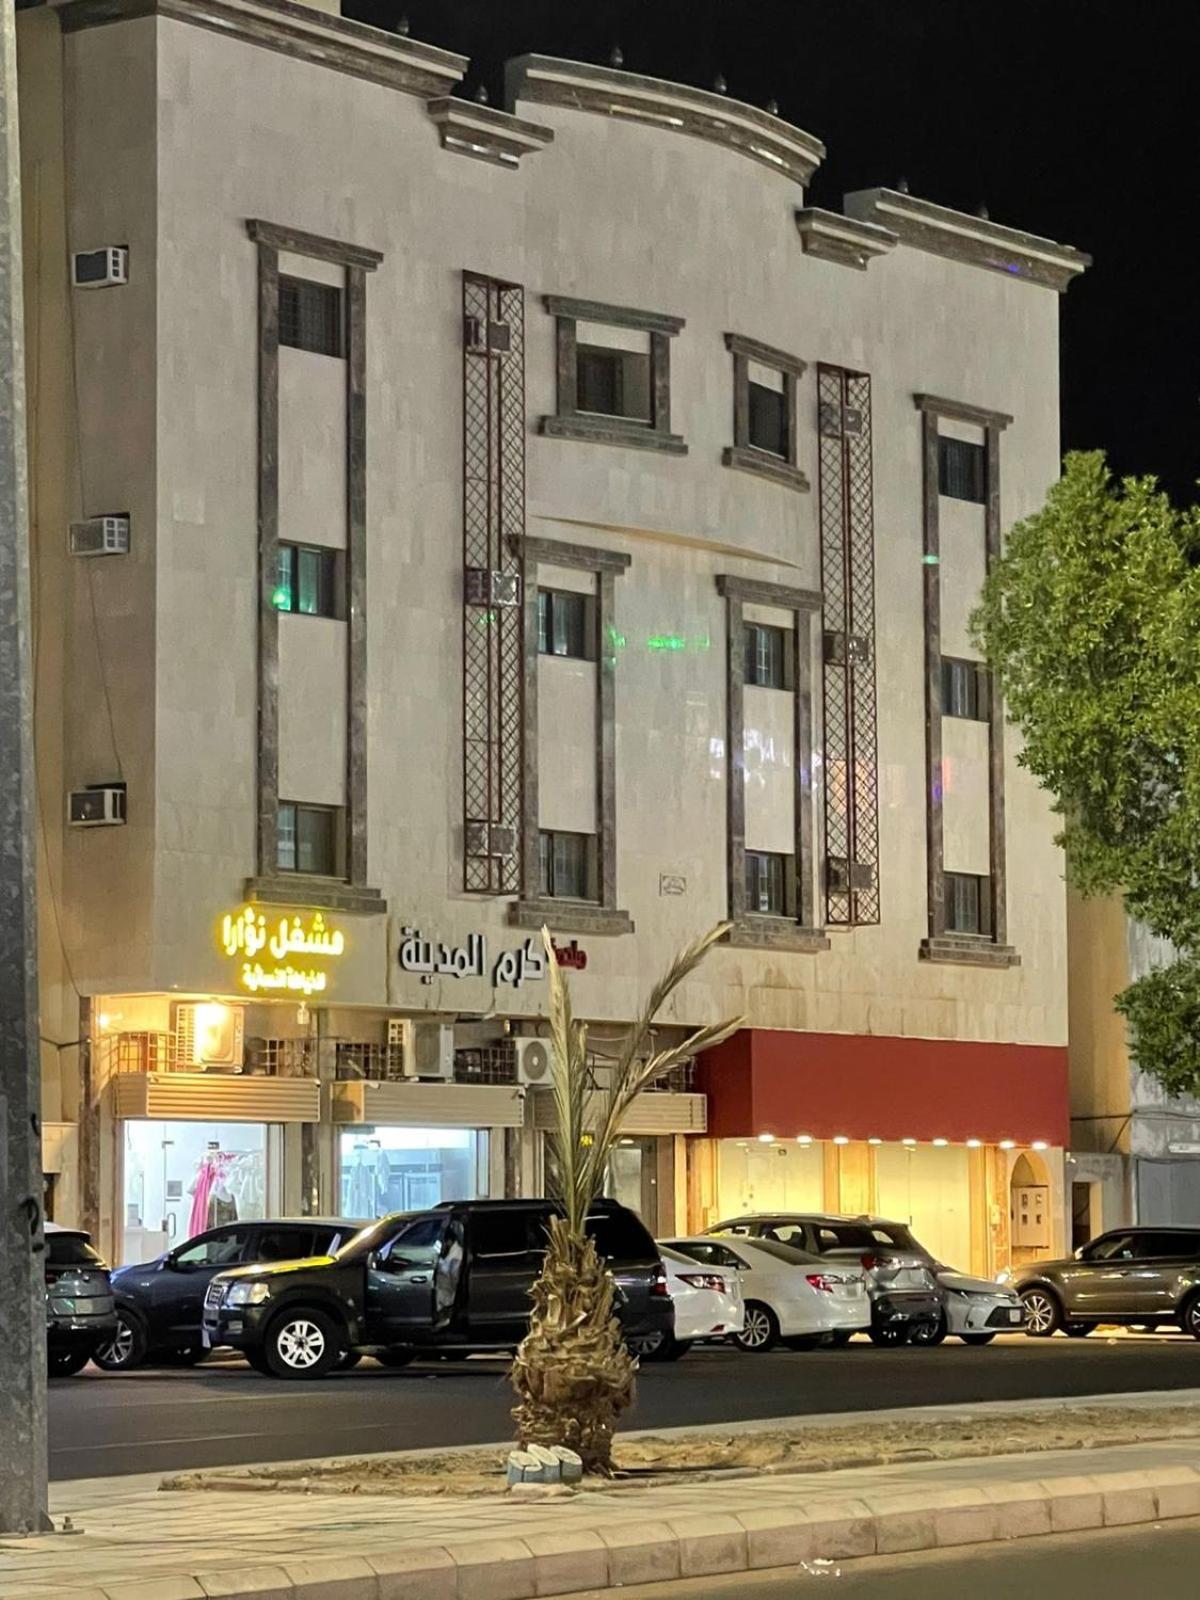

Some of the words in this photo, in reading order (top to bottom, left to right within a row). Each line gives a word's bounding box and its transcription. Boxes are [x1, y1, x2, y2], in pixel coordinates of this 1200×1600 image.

[269, 912, 345, 960] مشغل
[399, 926, 486, 985] المدينة
[492, 937, 545, 988] كرم
